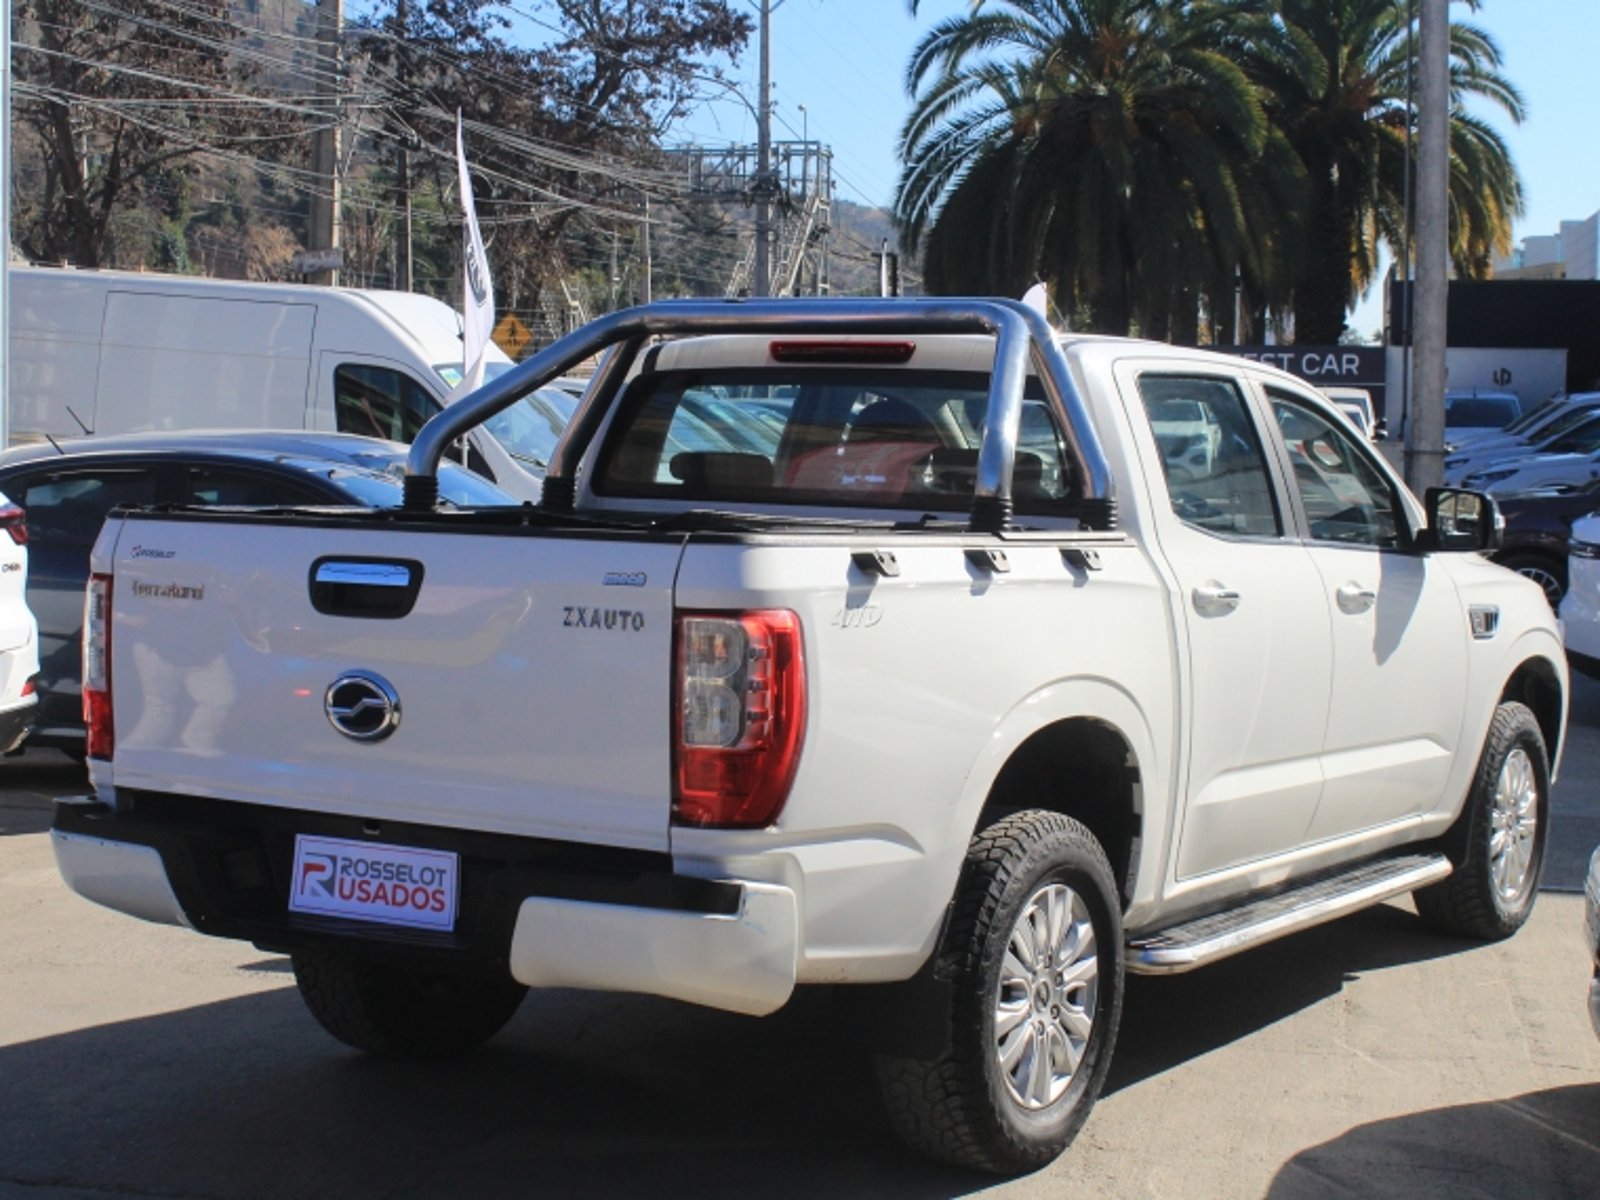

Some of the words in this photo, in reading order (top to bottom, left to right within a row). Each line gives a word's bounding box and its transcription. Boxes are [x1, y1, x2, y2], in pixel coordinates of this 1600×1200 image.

[1235, 353, 1295, 372] ST
[1302, 353, 1360, 375] CAR
[563, 606, 645, 632] ZXAUTO
[340, 857, 446, 887] ROSSELOT
[338, 878, 446, 912] USADOS
